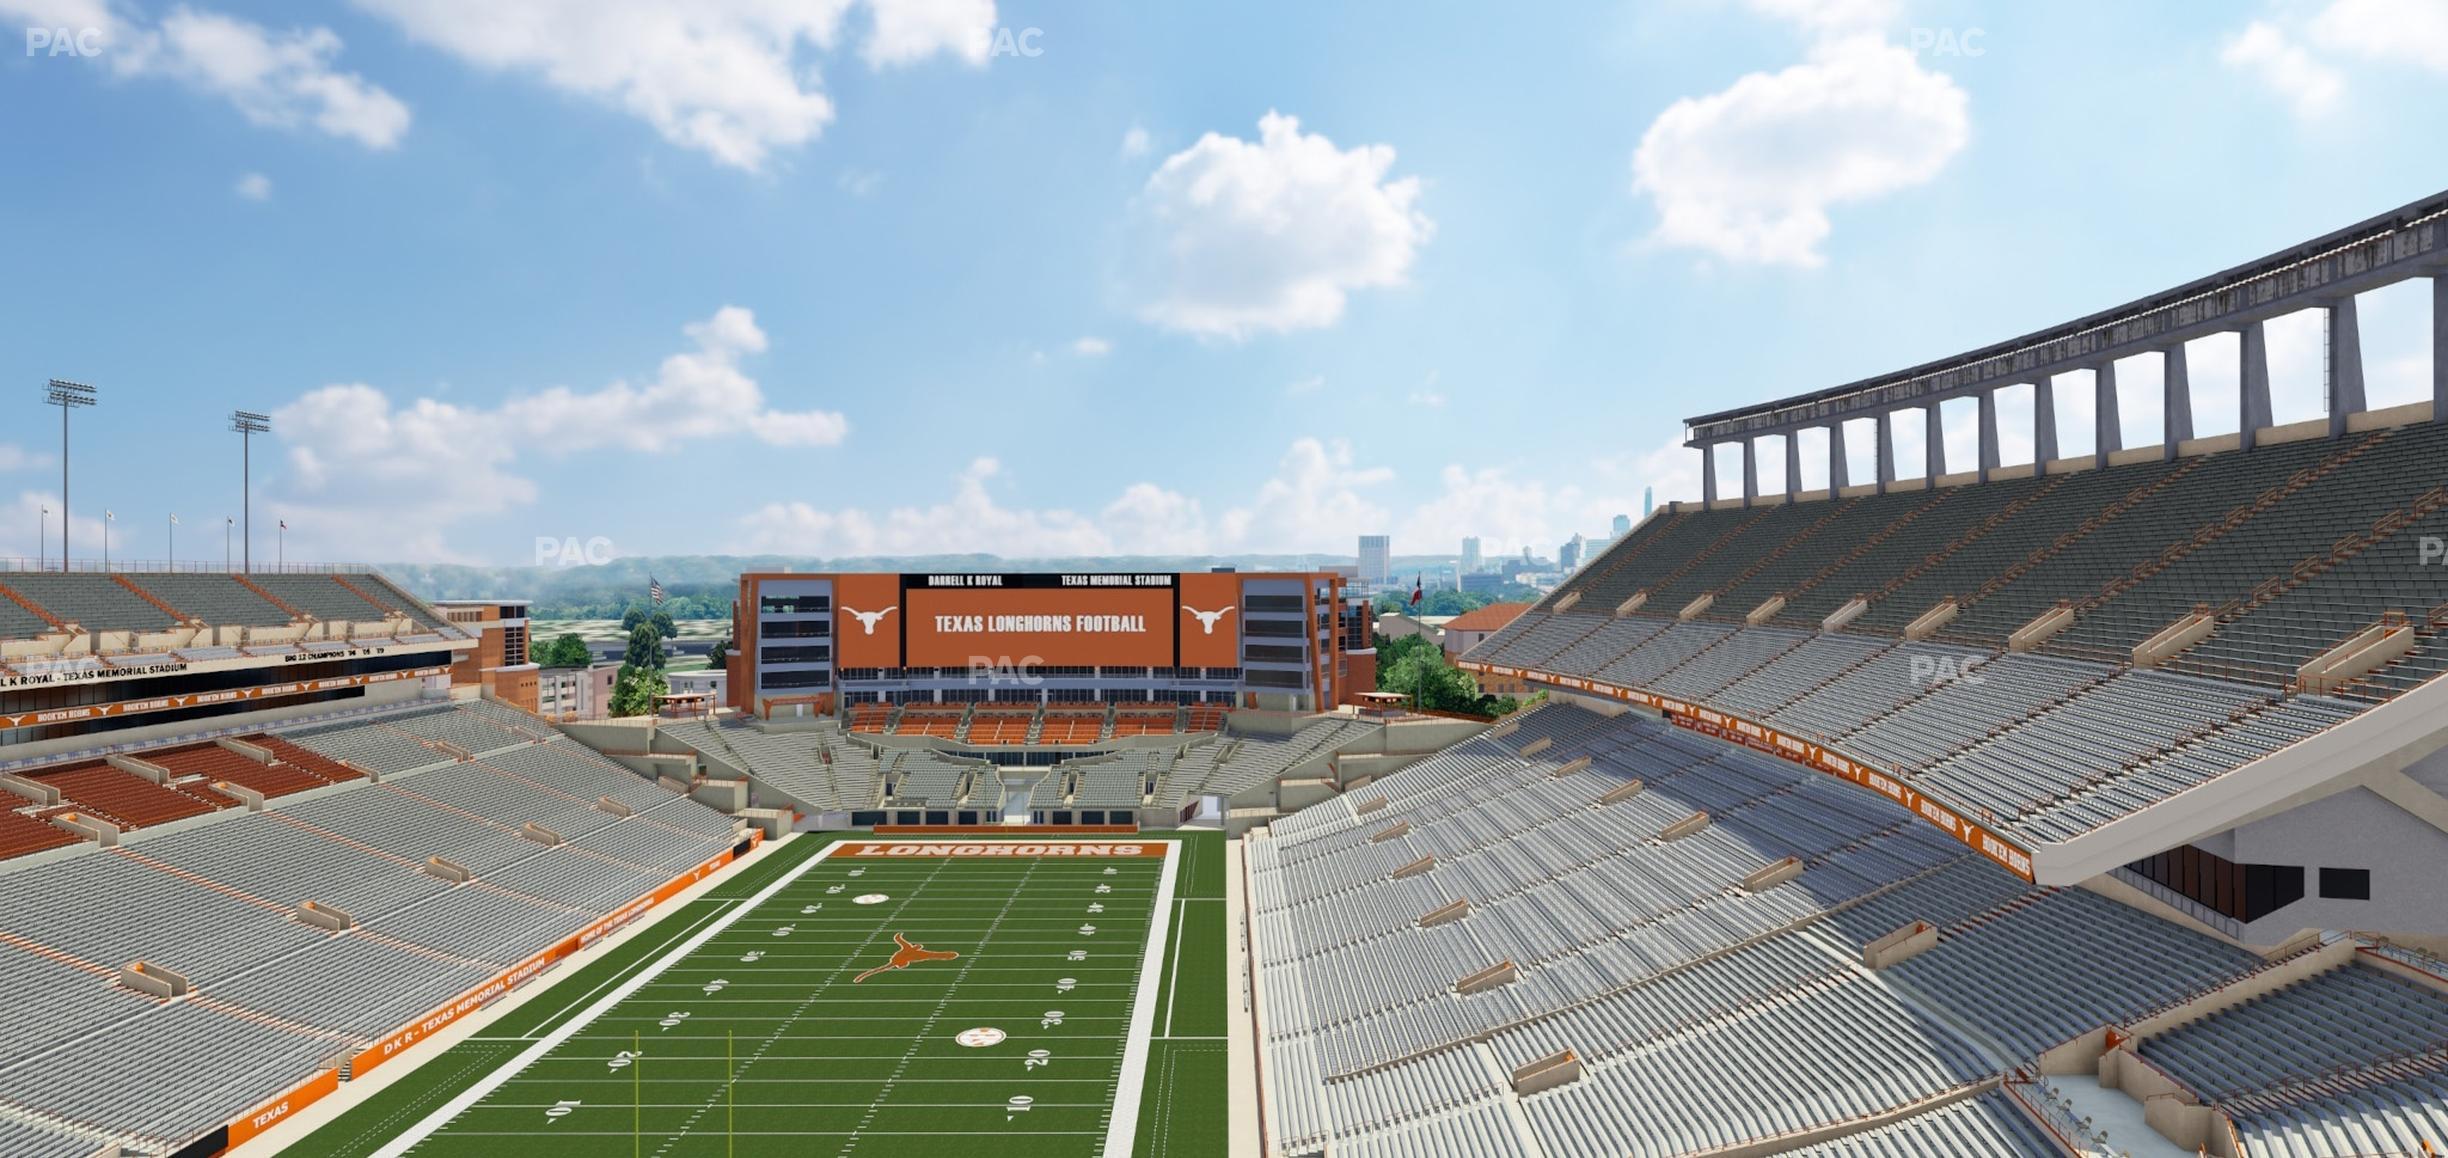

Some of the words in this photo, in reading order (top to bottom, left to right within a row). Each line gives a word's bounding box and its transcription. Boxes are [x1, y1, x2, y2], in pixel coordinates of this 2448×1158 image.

[928, 575, 964, 587] DARRELL
[967, 576, 973, 586] K
[975, 575, 1003, 586] ROYAL
[1062, 575, 1088, 586] TEXAS
[1090, 575, 1133, 586] MEMORIAL
[1135, 575, 1172, 586] STADIUM
[935, 615, 983, 633] TEXAS
[988, 615, 1072, 633] LONGHORNS
[1076, 615, 1147, 633] FOOTBALL
[10, 676, 17, 686] K
[20, 674, 54, 685] ROYAL
[63, 670, 94, 682] TEXAS
[97, 666, 147, 678] MEMORIAL
[149, 663, 188, 674] STADIUM
[855, 845, 1143, 856] LONGHORNS
[405, 1032, 413, 1043] R
[421, 1009, 454, 1032] TEXAS
[456, 981, 505, 1014] MEMORIAL
[507, 957, 545, 984] STADIUM
[1024, 1049, 1051, 1066] 20
[545, 1100, 581, 1116] 10
[1006, 1095, 1034, 1111] 10
[252, 1101, 288, 1128] TEXAS
